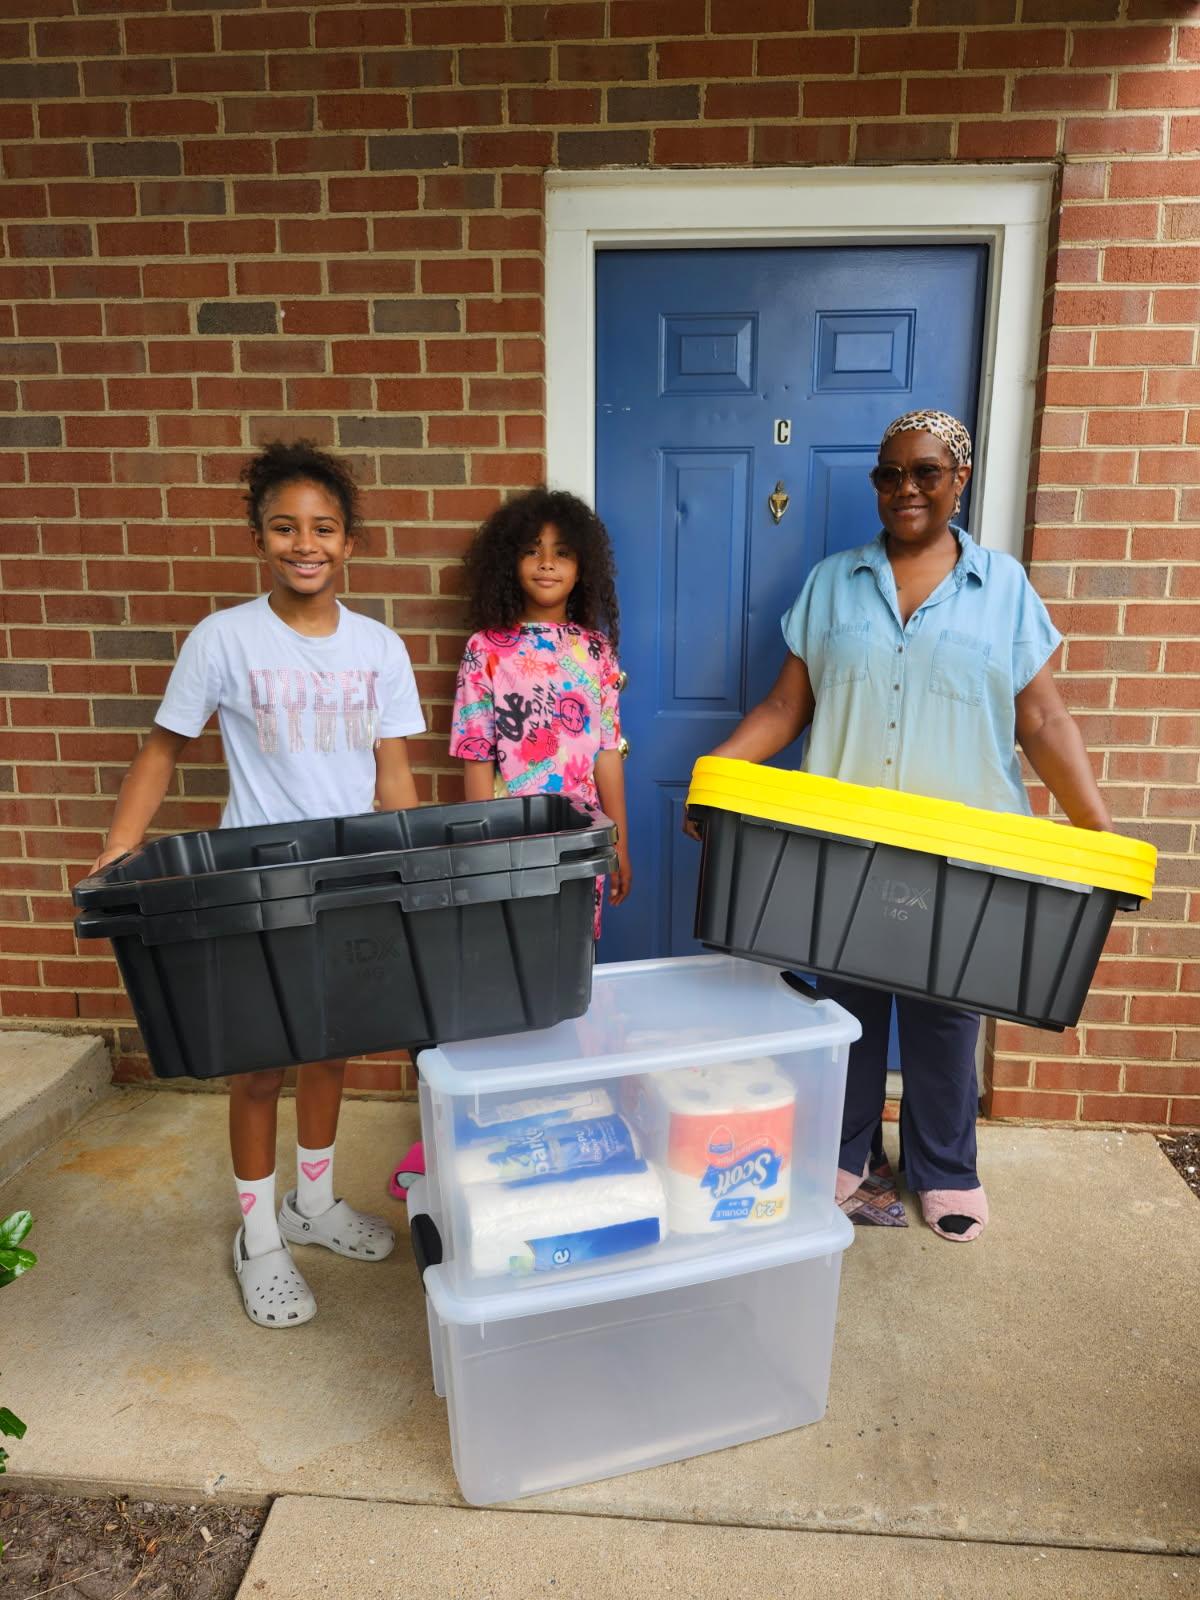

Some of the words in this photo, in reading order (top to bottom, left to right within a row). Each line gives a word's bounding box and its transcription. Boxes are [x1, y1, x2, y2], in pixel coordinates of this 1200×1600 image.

[777, 420, 789, 443] C
[527, 720, 540, 746] DAY
[713, 1153, 771, 1198] Scott
[714, 1207, 749, 1217] DOUBLE
[756, 1201, 777, 1217] 24
